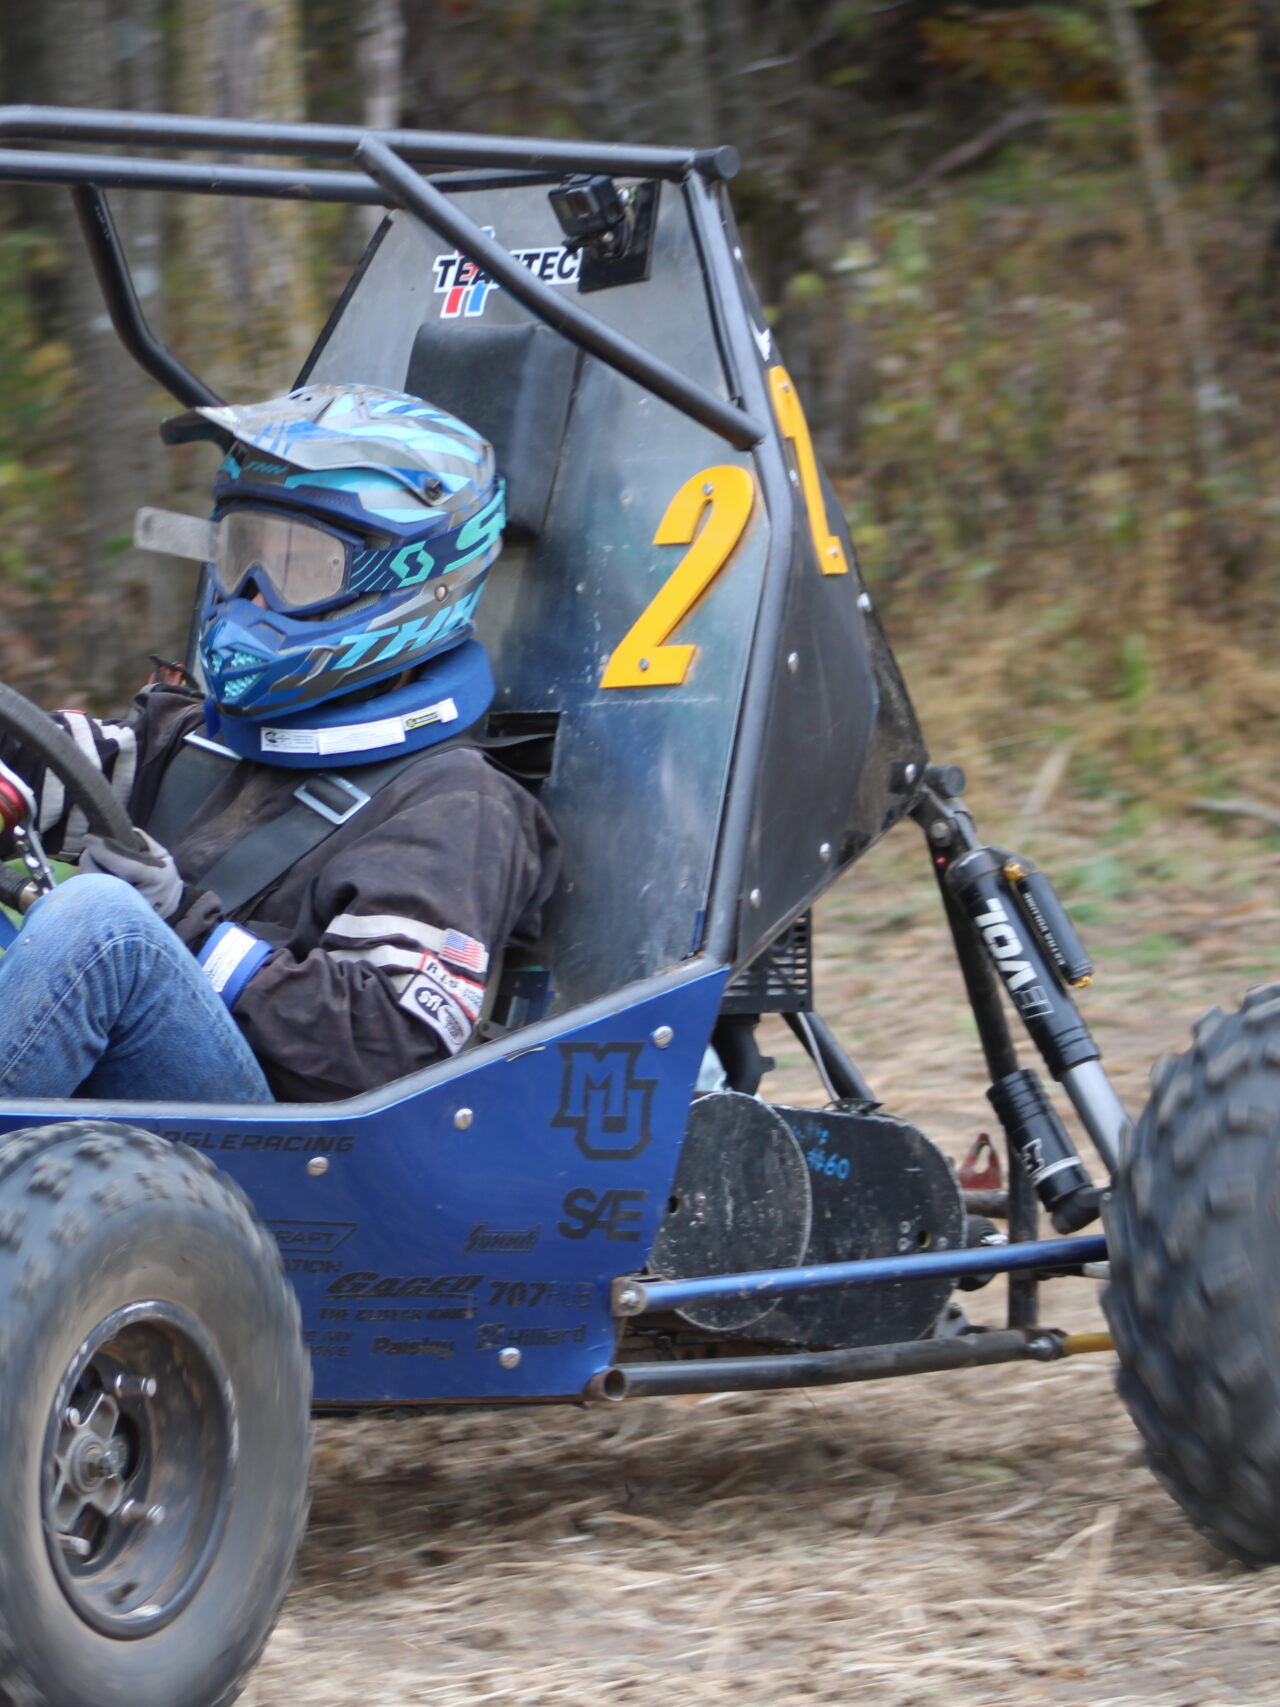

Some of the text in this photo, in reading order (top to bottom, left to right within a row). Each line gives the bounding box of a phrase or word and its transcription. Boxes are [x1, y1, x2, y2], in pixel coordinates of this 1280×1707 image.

[438, 250, 583, 288] TEATEC
[600, 465, 754, 688] 2
[974, 897, 1055, 1020] EVOL
[548, 1042, 660, 1160] MU
[806, 1149, 851, 1180] #60
[557, 1187, 648, 1242] SAE
